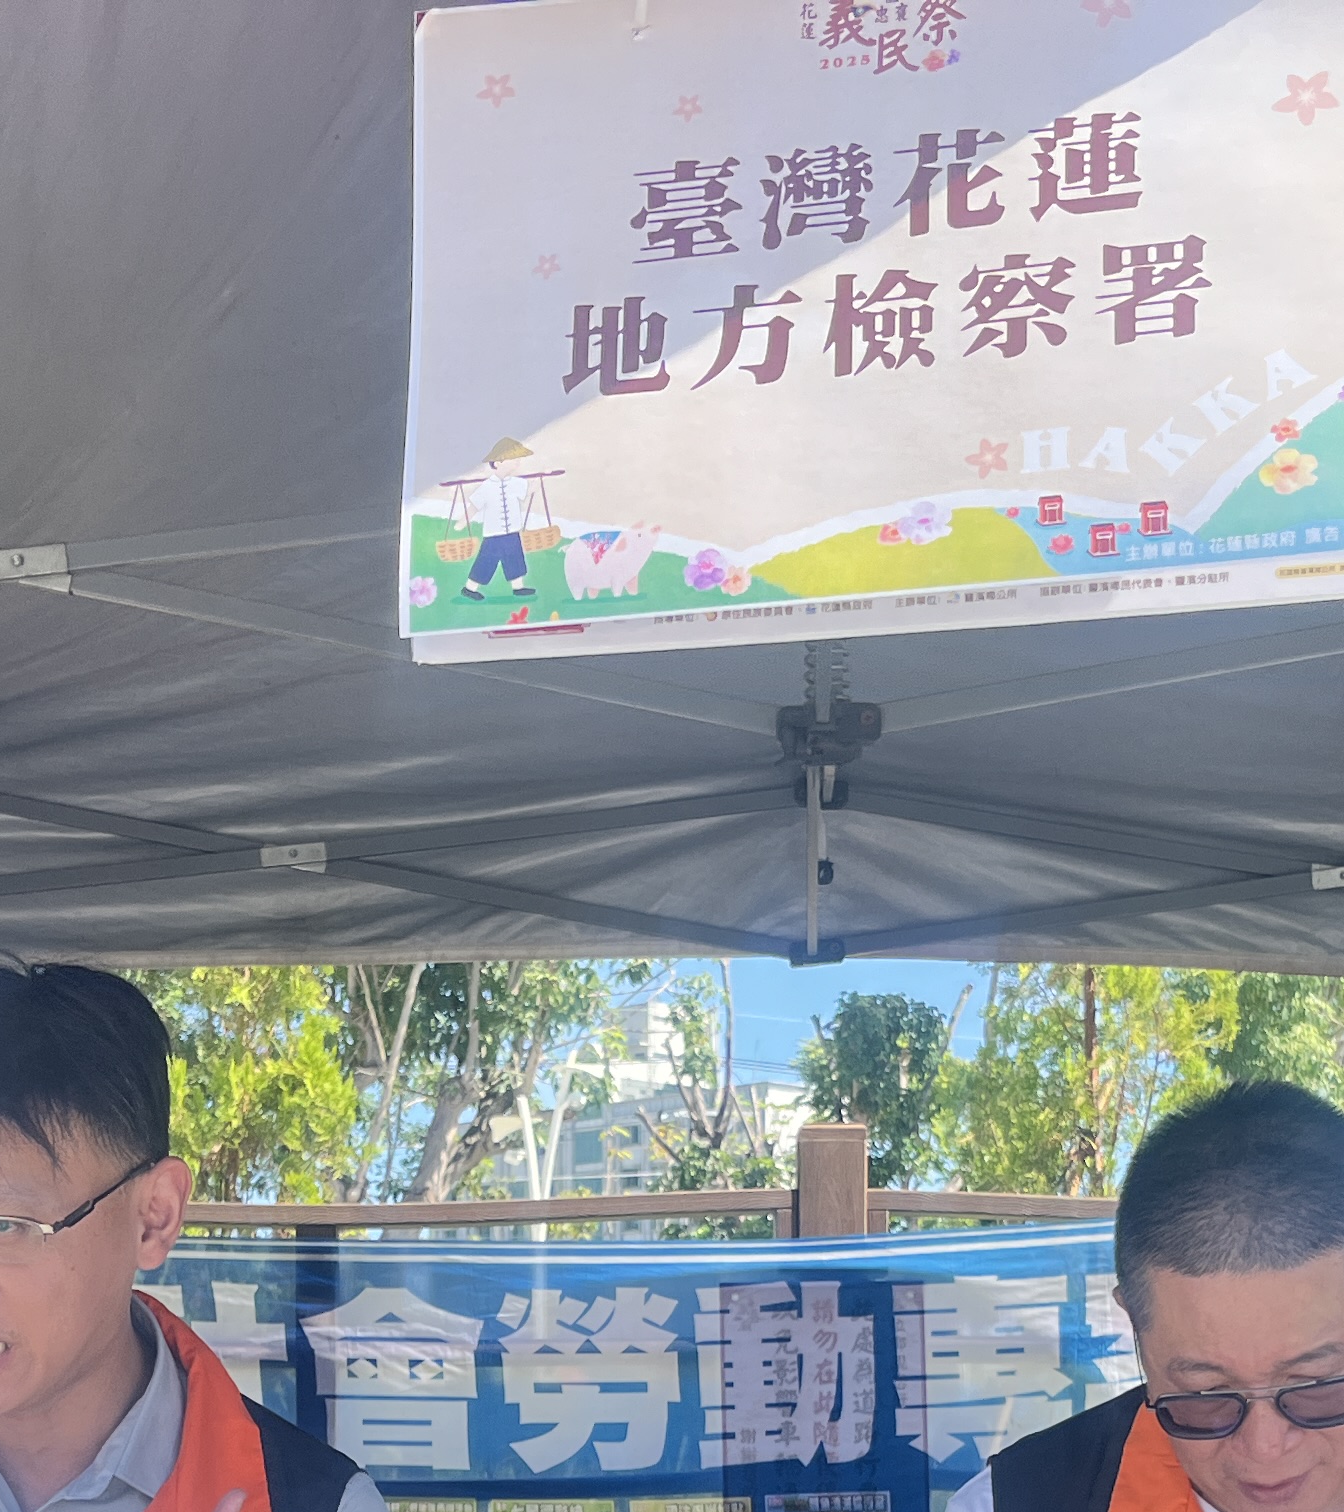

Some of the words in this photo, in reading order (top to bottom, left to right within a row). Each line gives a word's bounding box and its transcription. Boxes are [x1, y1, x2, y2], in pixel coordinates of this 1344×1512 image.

[630, 111, 1143, 265] 臺灣花蓮
[562, 233, 1213, 397] 地方檢察署
[1020, 349, 1319, 476] HAKKA
